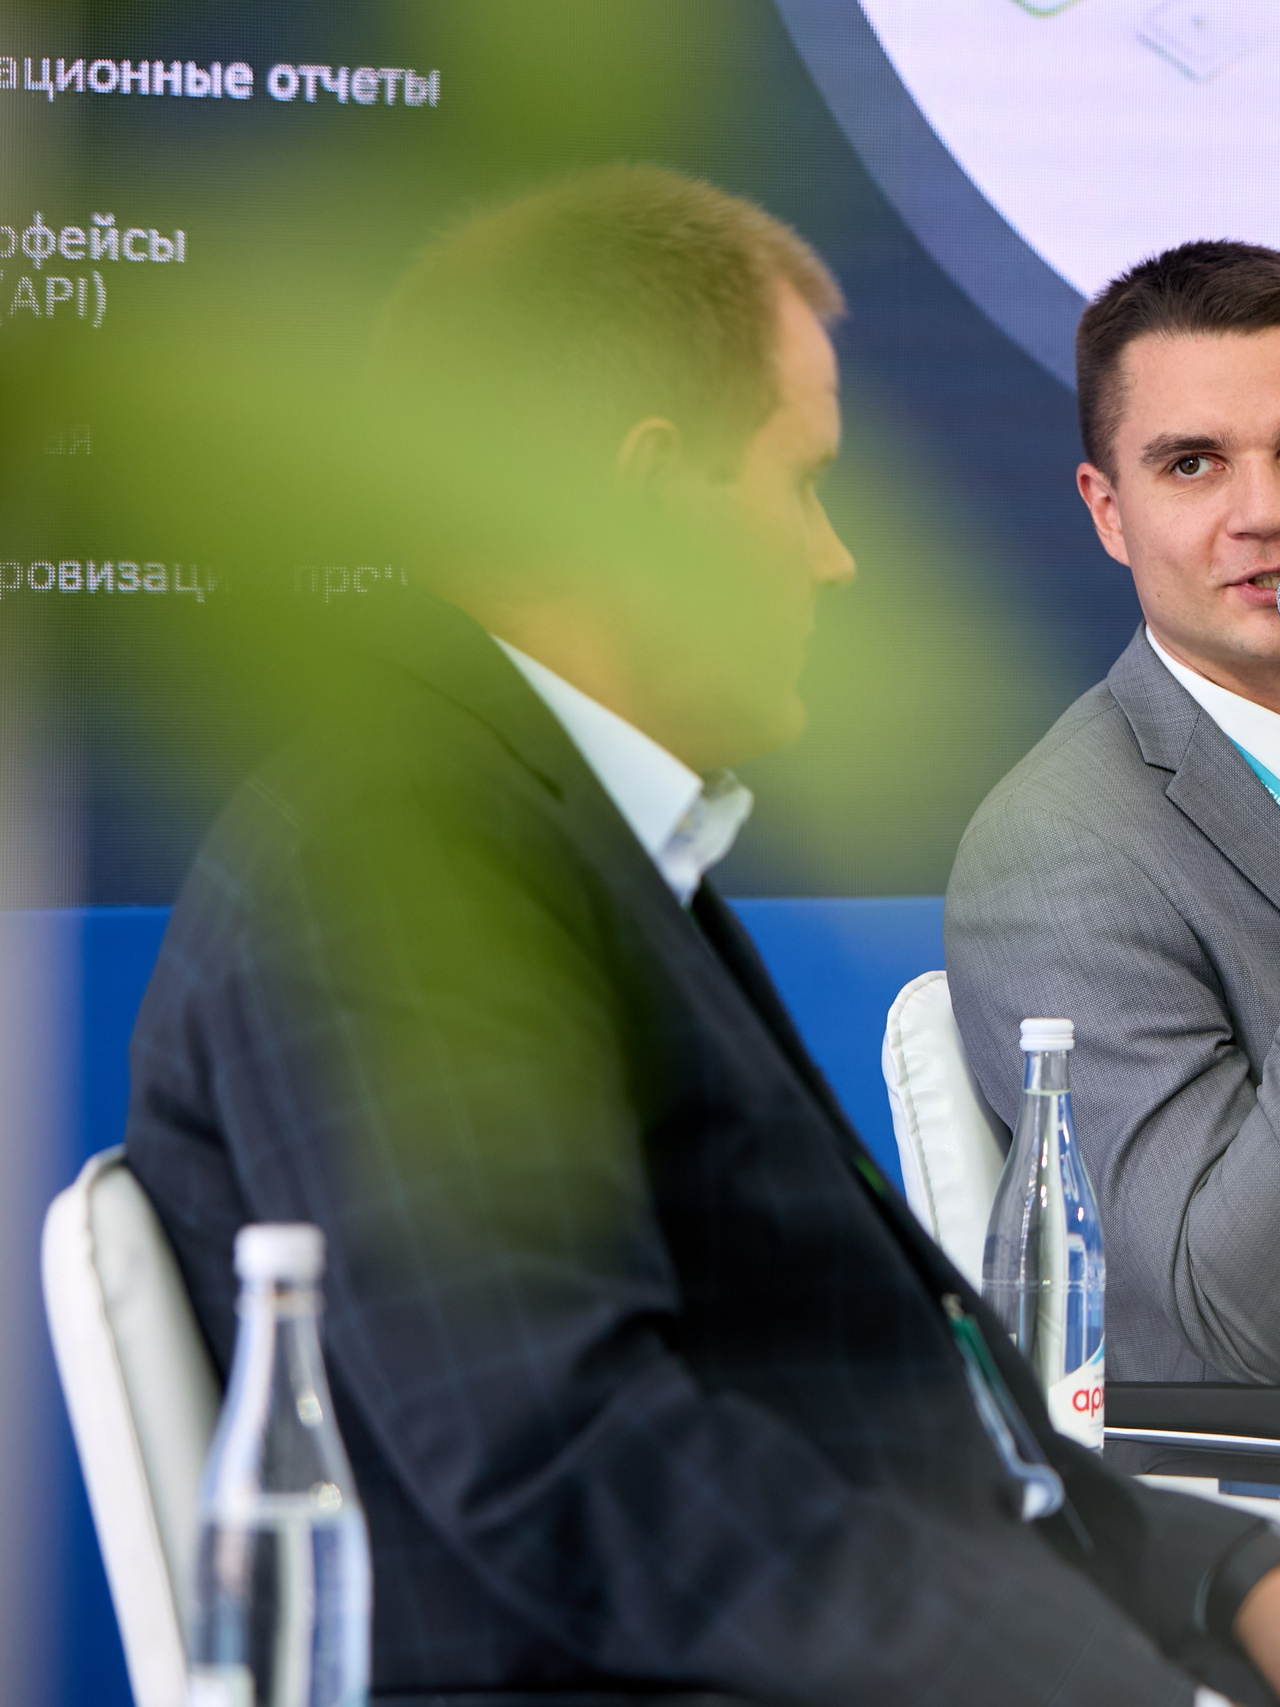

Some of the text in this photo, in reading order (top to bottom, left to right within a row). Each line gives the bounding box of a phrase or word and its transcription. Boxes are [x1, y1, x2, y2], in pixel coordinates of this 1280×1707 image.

[0, 56, 441, 107] ационные отчеты
[0, 269, 107, 329] API)
